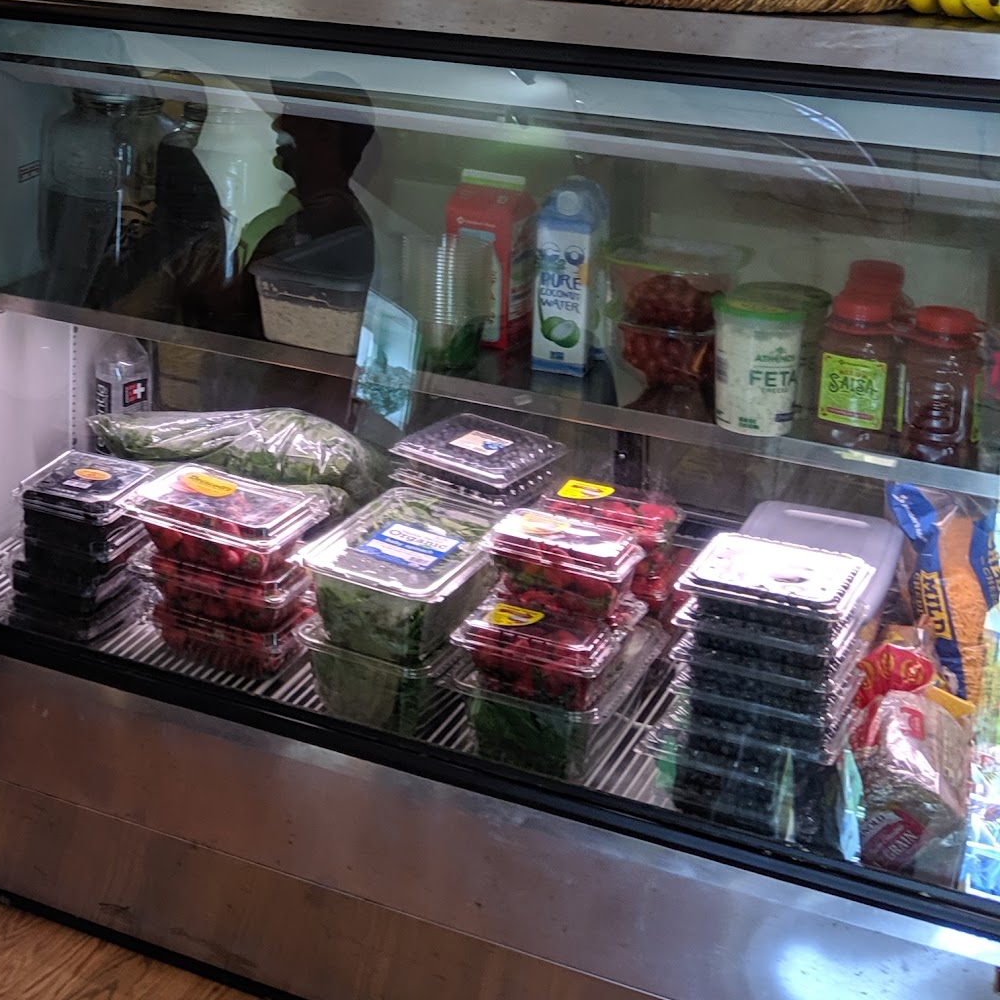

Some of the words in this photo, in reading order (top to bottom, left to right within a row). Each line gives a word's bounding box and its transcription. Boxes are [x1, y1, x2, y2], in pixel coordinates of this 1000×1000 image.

[540, 271, 581, 291] PURE
[541, 298, 581, 314] WATER
[755, 354, 795, 363] ATHENO
[749, 369, 798, 388] FETA
[828, 373, 878, 396] SALSA
[389, 529, 448, 550] Organic
[922, 579, 946, 633] MILD
